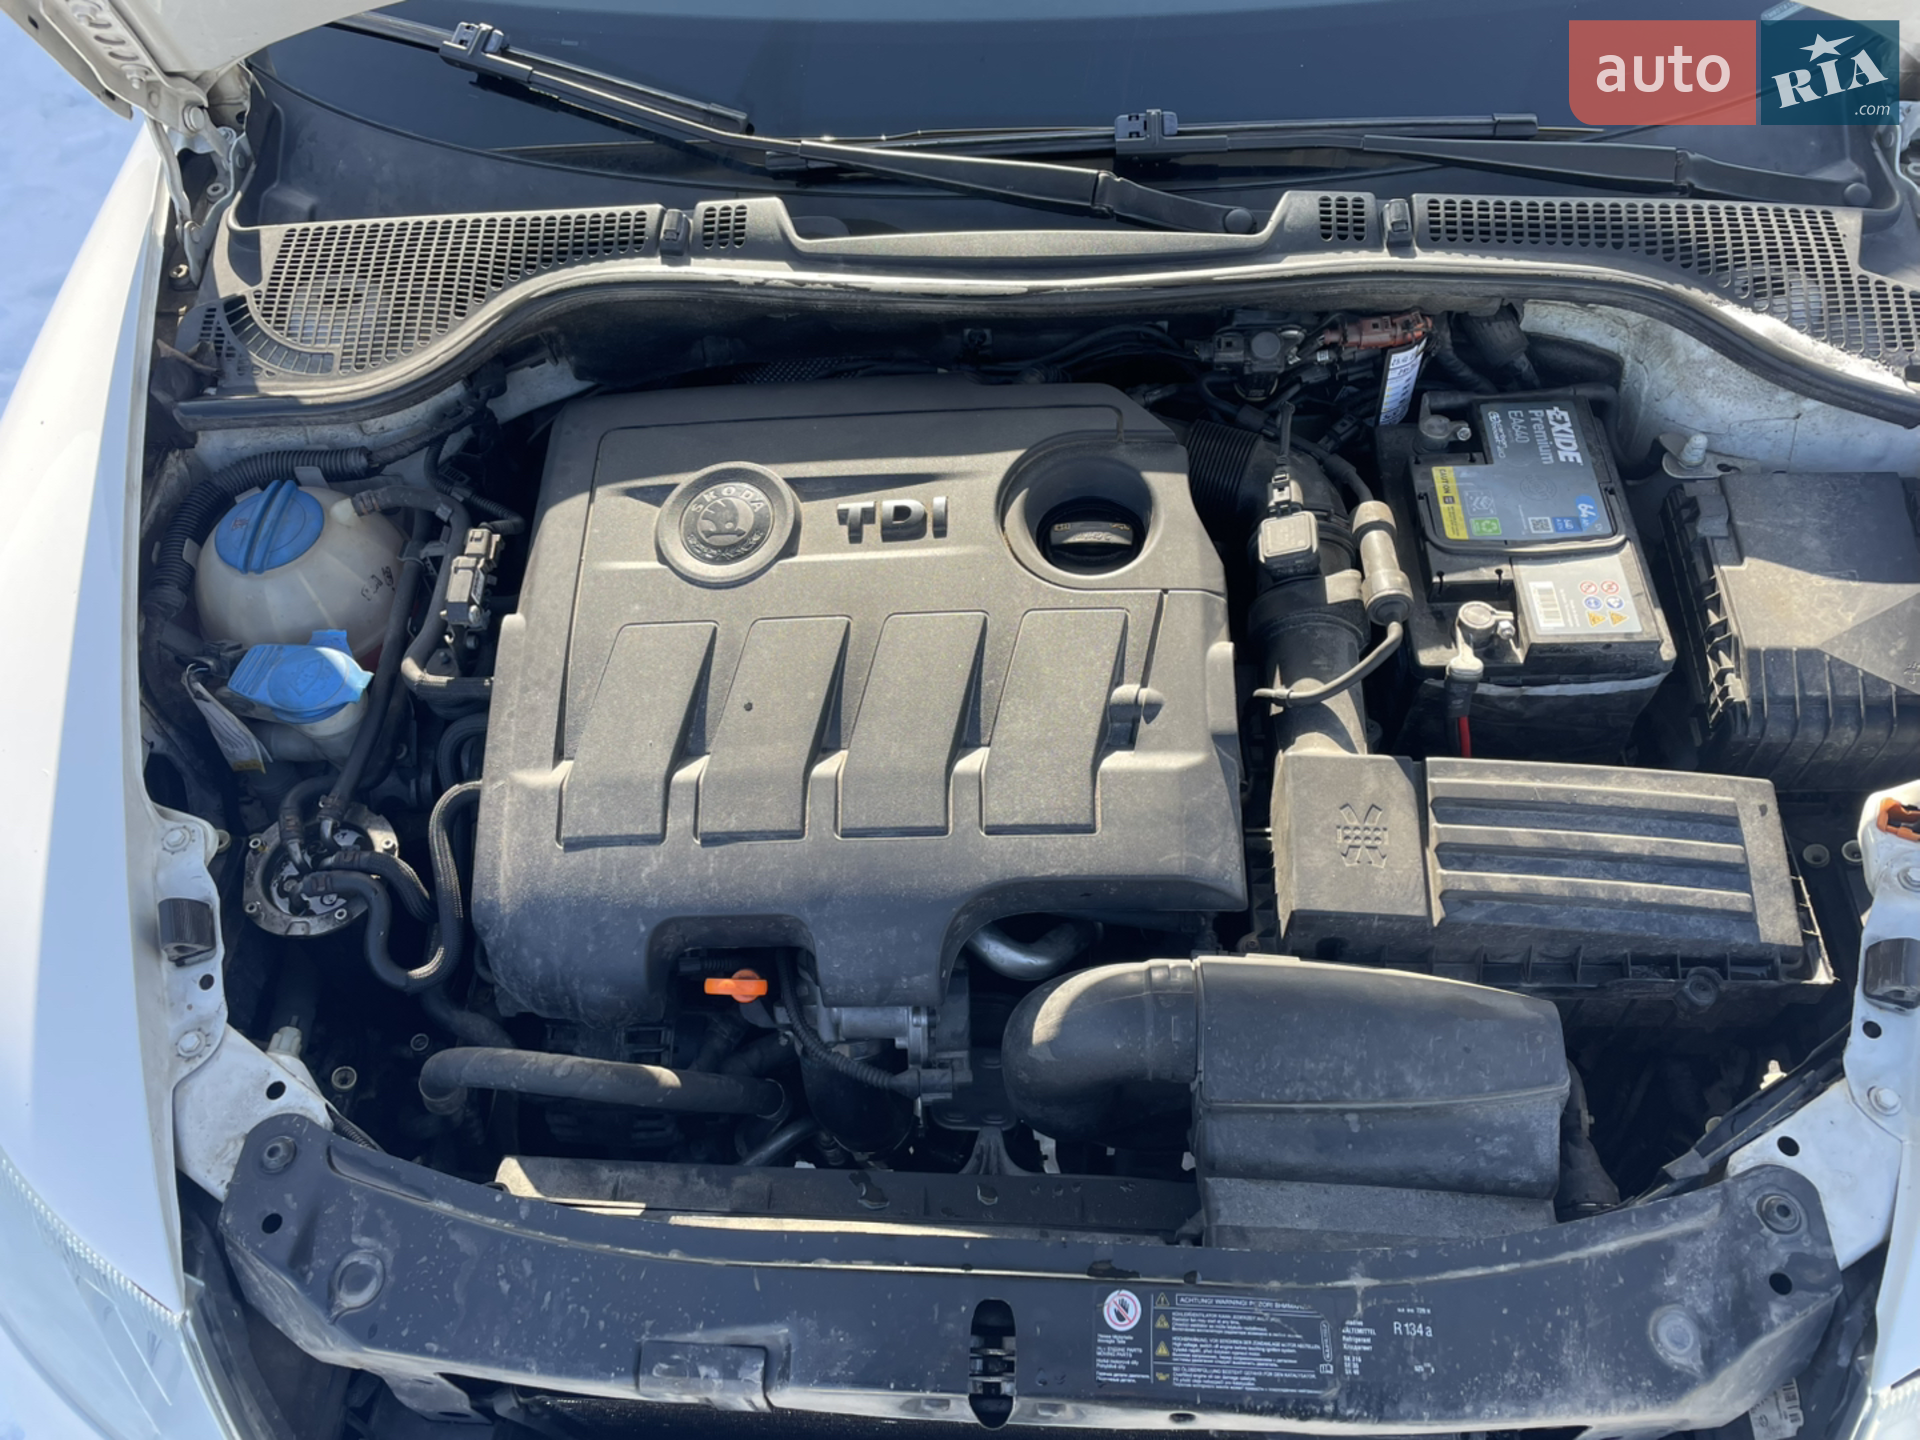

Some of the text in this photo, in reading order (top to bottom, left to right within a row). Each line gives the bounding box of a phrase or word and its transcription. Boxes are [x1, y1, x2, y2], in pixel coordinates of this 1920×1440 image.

[1508, 410, 1530, 443] EA640
[1528, 410, 1554, 465] Premium
[1545, 406, 1581, 463] EXIDE
[837, 496, 949, 544] TDI
[1578, 503, 1596, 518] 64
[1249, 1301, 1274, 1309] PZOR!
